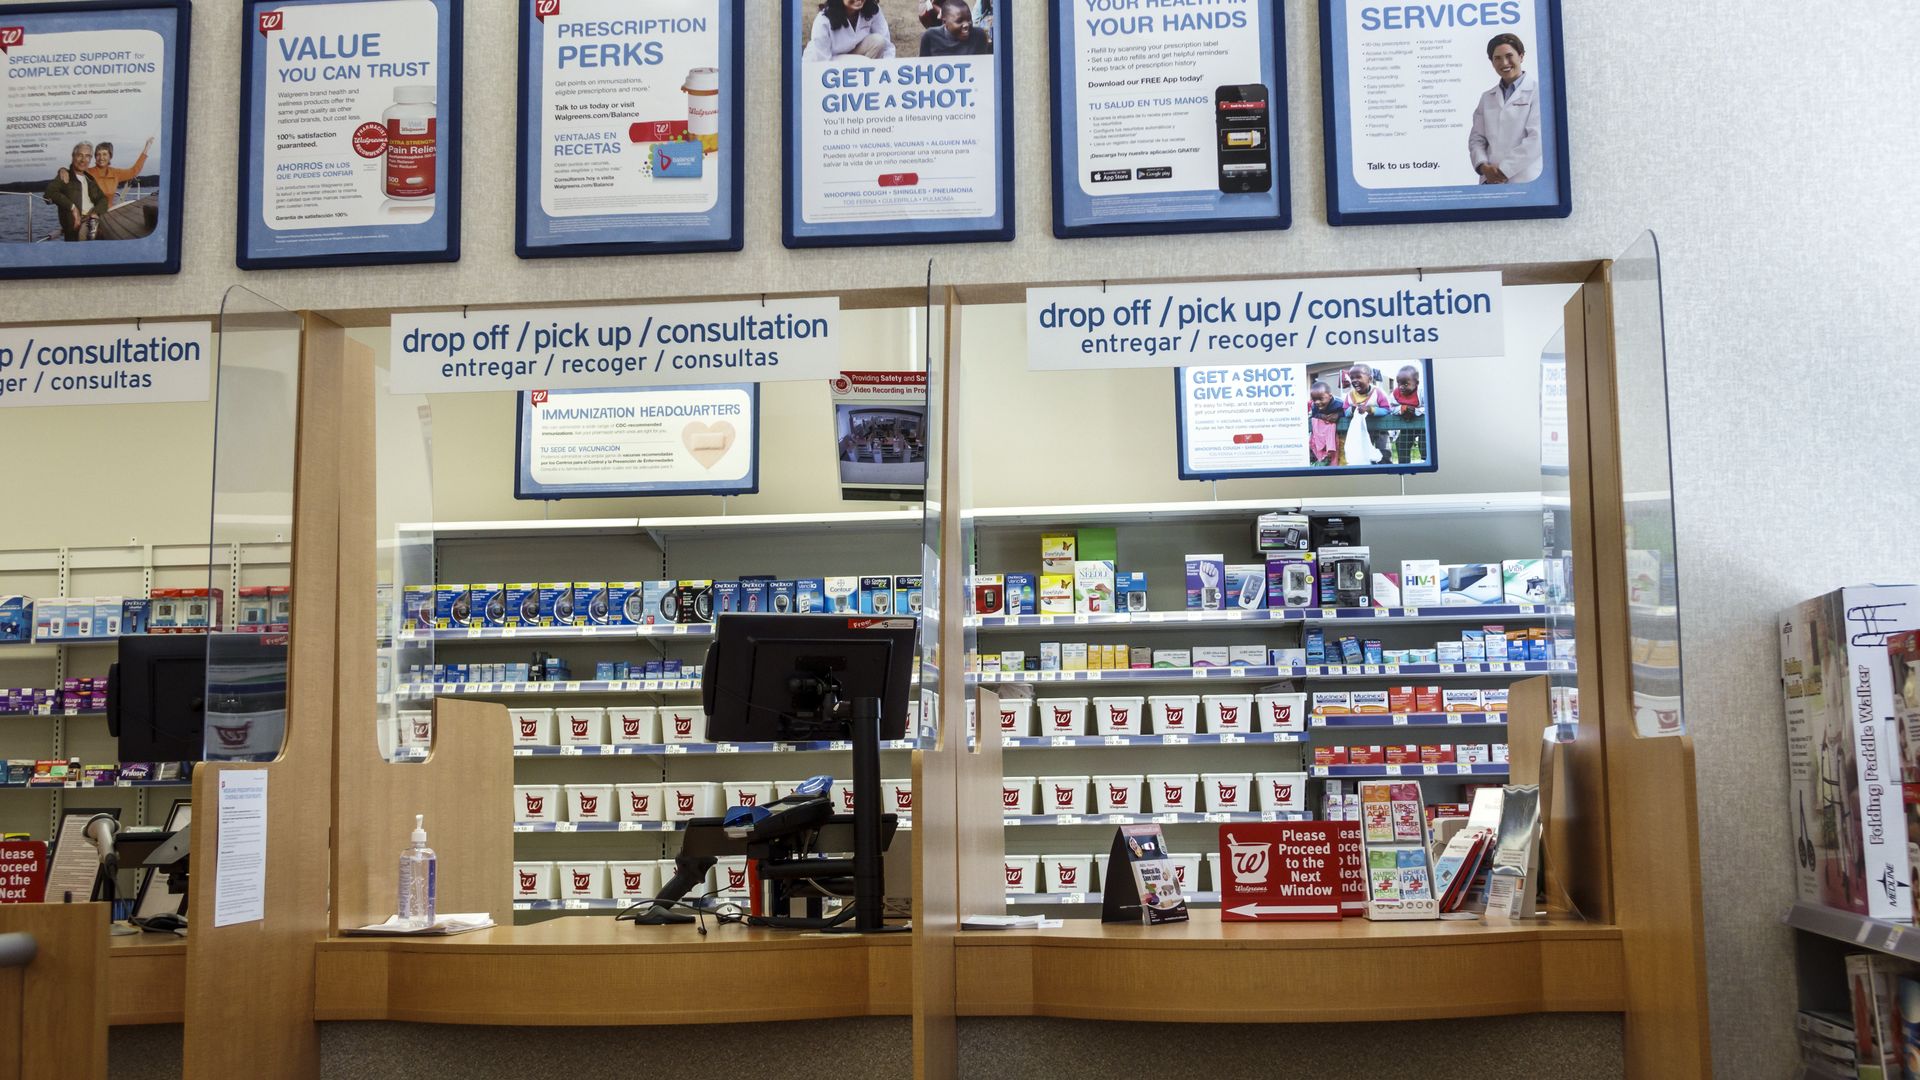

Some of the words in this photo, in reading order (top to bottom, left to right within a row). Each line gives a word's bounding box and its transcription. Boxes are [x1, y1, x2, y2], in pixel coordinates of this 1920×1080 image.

[1086, 15, 1154, 36] YOUR
[1163, 10, 1247, 32] HANDS
[1360, 1, 1520, 31] SERVICES
[557, 18, 706, 38] PRESCRIPTION
[278, 33, 381, 62] VALUE
[1118, 45, 1146, 54] scanning
[1164, 41, 1201, 51] prescription
[9, 53, 76, 65] SPECIALIZED
[80, 51, 131, 62] SUPPORT
[558, 41, 664, 69] PERKS
[9, 66, 70, 79] COMPLEX
[74, 62, 155, 76] CONDITIONS
[278, 67, 316, 83] YOU
[323, 65, 361, 81] CAN
[367, 62, 430, 78] TRUST
[821, 66, 876, 89] GET
[878, 70, 891, 84] A
[897, 63, 974, 86] SHOT.
[1088, 79, 1126, 89] Download
[1141, 76, 1161, 85] FREE
[1163, 75, 1177, 84] App
[278, 91, 308, 100] Walgreens
[309, 89, 327, 97] brand
[328, 88, 347, 96] health
[821, 92, 881, 113] GIVE
[884, 94, 897, 109] A
[901, 88, 975, 110] SHOT.
[278, 99, 302, 107] wellness
[304, 98, 329, 107] products
[590, 102, 609, 111] today
[1089, 103, 1102, 111] TU
[1103, 101, 1135, 110] SALUD
[1137, 99, 1151, 108] EN
[1153, 98, 1172, 107] TUS
[1174, 96, 1209, 105] MANOS
[554, 111, 640, 122] Walgreens.com/Balance
[823, 117, 845, 126] You'll
[847, 116, 864, 127] help
[866, 115, 896, 126] provide
[905, 113, 943, 123] lifesaving
[945, 112, 976, 121] vaccine
[277, 133, 296, 141] 100%
[297, 131, 337, 140] satisfaction
[554, 133, 601, 142] VENTAJAS
[603, 132, 617, 140] EN
[823, 128, 832, 136] to
[840, 126, 860, 135] child
[862, 126, 869, 134] in
[277, 141, 317, 151] guaranteed.
[388, 146, 408, 154] Pain
[554, 142, 621, 156] RECETAS
[276, 162, 323, 172] AHORROS
[1367, 162, 1386, 171] Talk
[1387, 162, 1397, 170] to
[1399, 162, 1411, 170] us
[1412, 160, 1441, 171] today.
[276, 173, 292, 181] QUE
[293, 171, 321, 179] PUEDES
[322, 170, 353, 178] CONFIAR
[823, 191, 862, 199] WHOOPING
[862, 189, 887, 197] COUGH
[932, 186, 973, 194] PNEUMONIA
[1039, 302, 1105, 333] drop
[1113, 298, 1152, 326] off
[1179, 296, 1237, 330] pick
[1245, 300, 1281, 327] up
[1308, 287, 1491, 319] consultation
[402, 328, 465, 357] drop
[473, 324, 510, 351] off
[535, 322, 590, 354] pick
[598, 325, 632, 351] up
[656, 313, 828, 344] consultation
[1081, 334, 1182, 356] entregar
[1208, 332, 1299, 352] recoger
[1326, 324, 1439, 346] consultas
[37, 337, 200, 365] consultation
[442, 358, 538, 380] entregar
[562, 355, 647, 376] recoger
[672, 348, 779, 369] consultas
[51, 370, 152, 390] consultas
[852, 374, 880, 383] Providing
[880, 374, 902, 383] Safety
[1193, 368, 1232, 385] GET
[1232, 371, 1240, 381] A
[1242, 367, 1295, 383] SHOT.
[872, 386, 905, 395] Recording
[906, 386, 912, 394] in
[1193, 385, 1232, 401] GIVE
[1235, 388, 1243, 397] A
[1246, 384, 1295, 399] SHOT.
[542, 407, 635, 420] IMMUNIZATION
[640, 404, 740, 418] HEADQUARTERS
[1405, 575, 1436, 586] HIV-1
[1316, 693, 1343, 701] Mucinex
[1446, 691, 1473, 699] Mucinex
[1858, 665, 1874, 722] Walker
[1861, 725, 1880, 783] Paddle
[121, 769, 147, 778] Prilosec
[1869, 783, 1885, 846] Folding
[1282, 829, 1326, 842] Please
[1278, 842, 1331, 855] Proceed
[1234, 852, 1266, 873] W
[1286, 857, 1299, 868] to
[1302, 856, 1324, 868] the
[10, 874, 31, 886] the
[1291, 870, 1321, 882] Next
[1234, 884, 1268, 893] Walgreens
[1280, 883, 1333, 896] Window
[1884, 863, 1898, 908] MEDLINE
